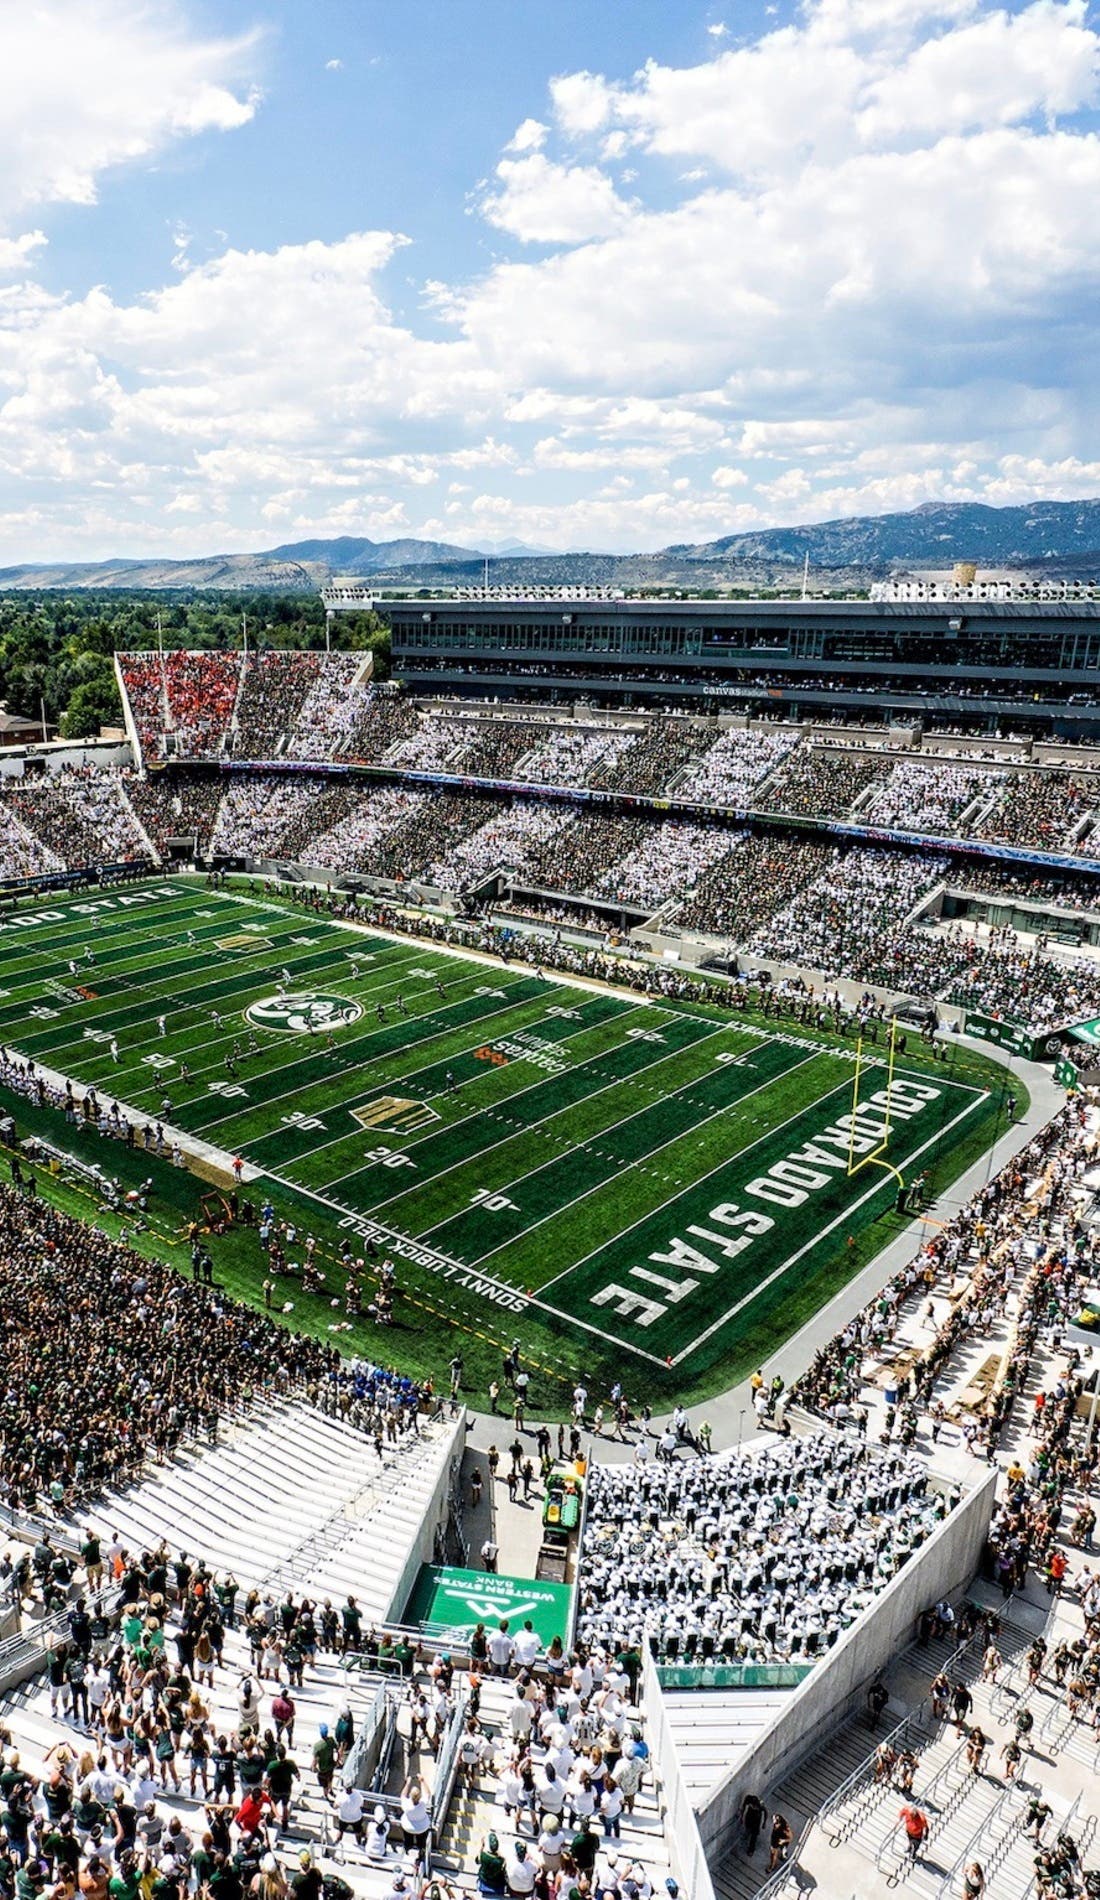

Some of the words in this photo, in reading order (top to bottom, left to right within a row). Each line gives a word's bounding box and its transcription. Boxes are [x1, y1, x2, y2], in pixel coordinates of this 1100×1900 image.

[703, 686, 740, 696] canvas
[69, 887, 184, 914] STATE
[141, 1053, 177, 1069] 50
[208, 1082, 245, 1098] 40
[281, 1112, 322, 1131] 30
[744, 1078, 942, 1208] COLORADO
[364, 1147, 410, 1169] 20
[470, 1188, 513, 1212] 10
[338, 1216, 391, 1245] FIELD
[386, 1240, 458, 1278] LUBICK
[589, 1203, 776, 1327] STATE
[454, 1275, 530, 1313] SONNY
[433, 1576, 484, 1591] STATES
[475, 1576, 514, 1587] BANK
[484, 1585, 556, 1602] WESTERN
